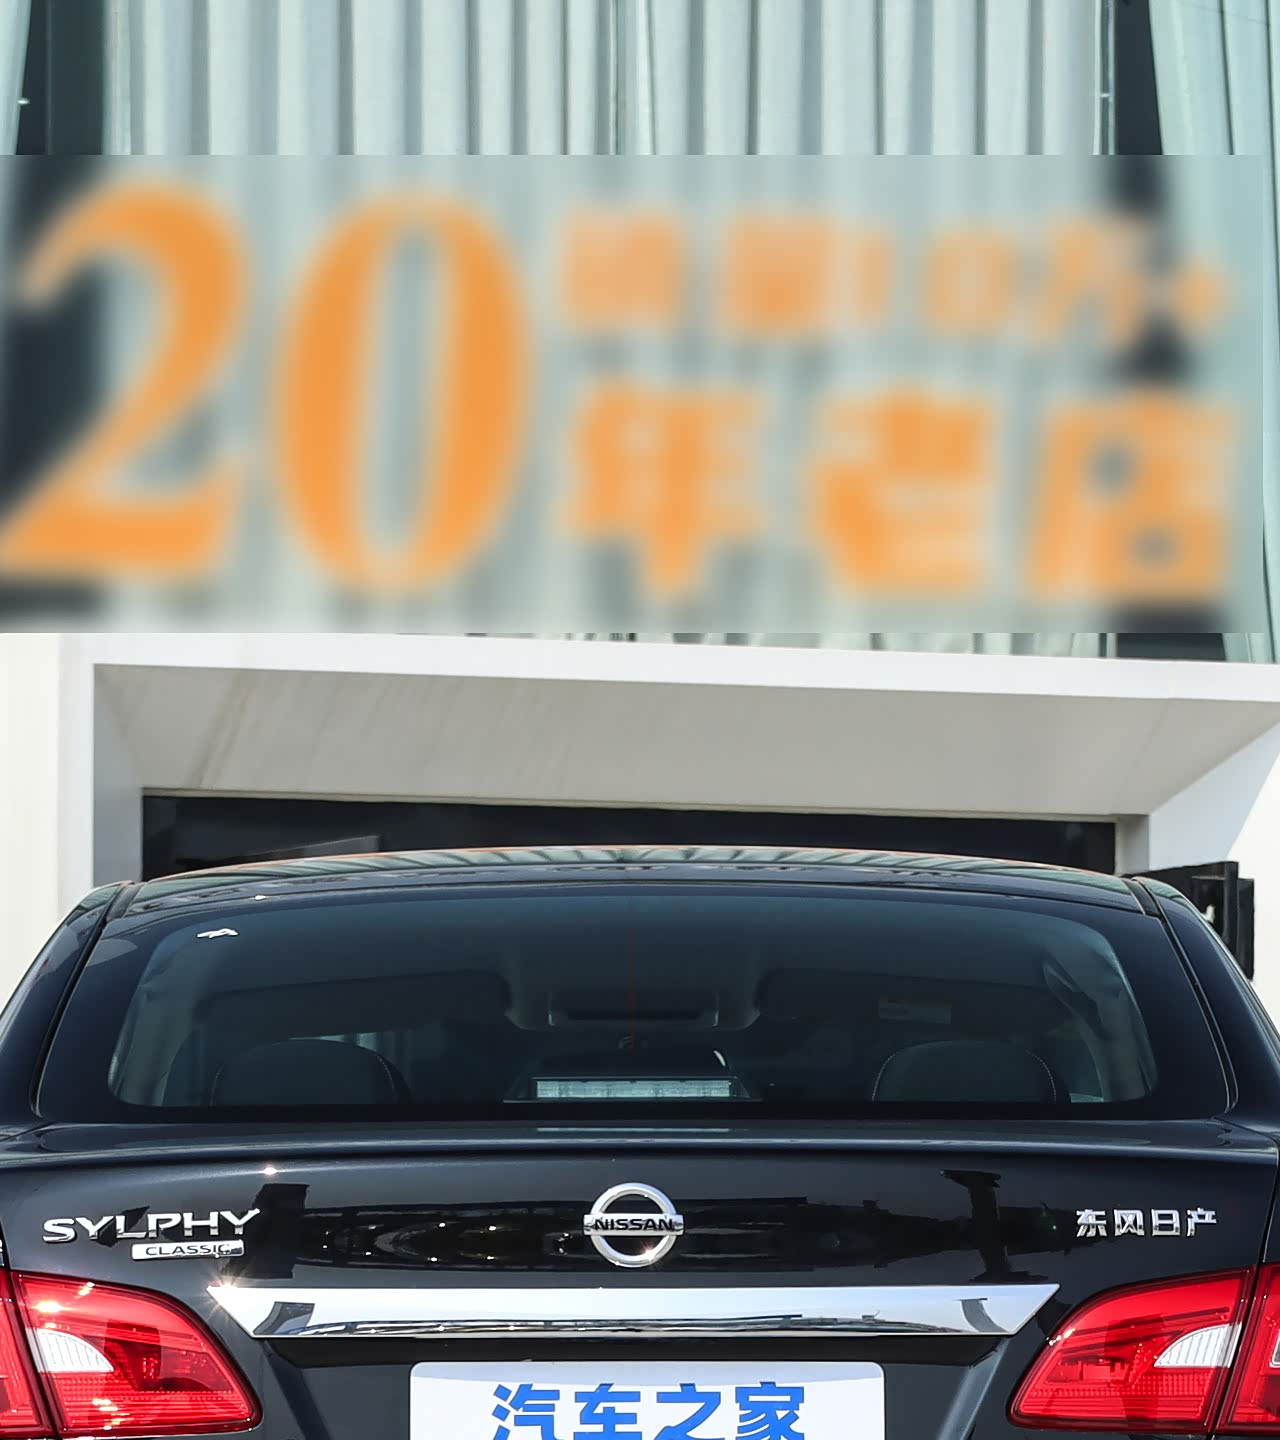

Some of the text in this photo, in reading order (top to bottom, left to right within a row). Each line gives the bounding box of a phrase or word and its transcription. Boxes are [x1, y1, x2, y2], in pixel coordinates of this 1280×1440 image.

[42, 1207, 261, 1243] SYLPHY
[594, 1218, 675, 1232] NISSAN
[1076, 1207, 1218, 1238] 东风日产
[145, 1243, 232, 1257] CLASSIC
